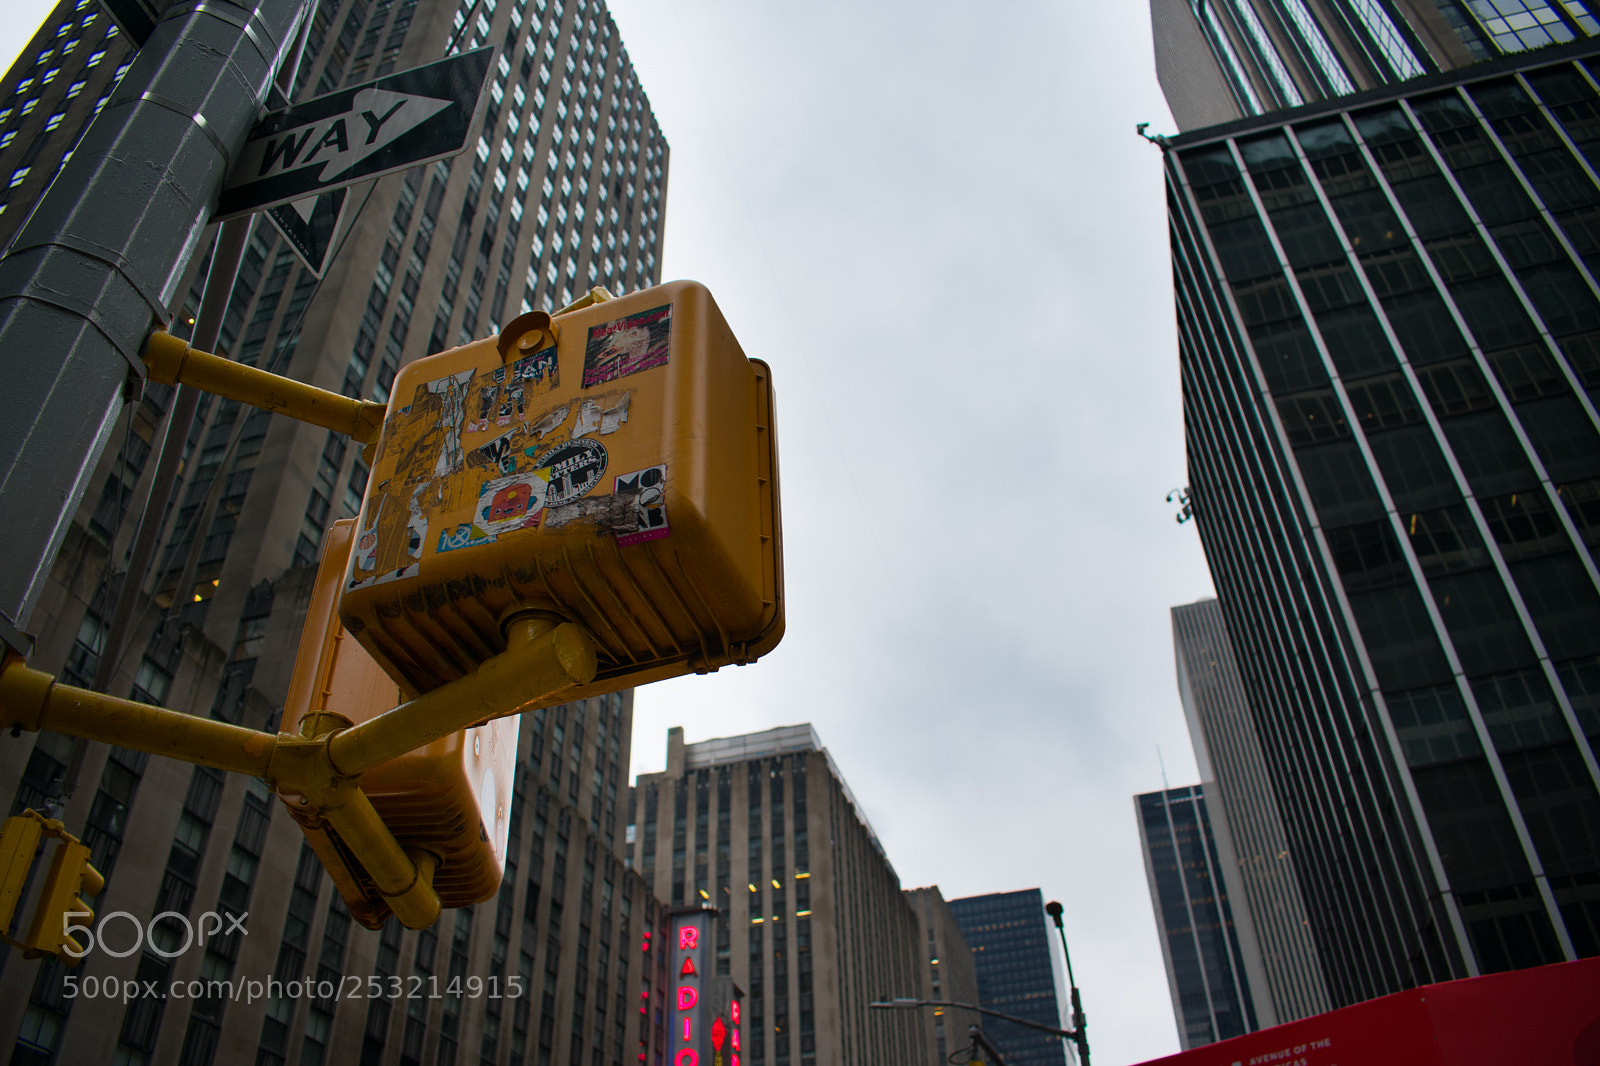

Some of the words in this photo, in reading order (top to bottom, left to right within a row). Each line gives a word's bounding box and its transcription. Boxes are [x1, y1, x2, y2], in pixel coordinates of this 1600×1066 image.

[258, 99, 408, 176] WAY
[272, 208, 310, 257] ORTATION
[592, 310, 669, 339] MeatVideo.com
[551, 448, 595, 472] MILY
[674, 925, 699, 1066] RADIO
[1249, 1048, 1291, 1066] AVENUE
[1293, 1043, 1307, 1055] OF
[1309, 1037, 1331, 1051] THE
